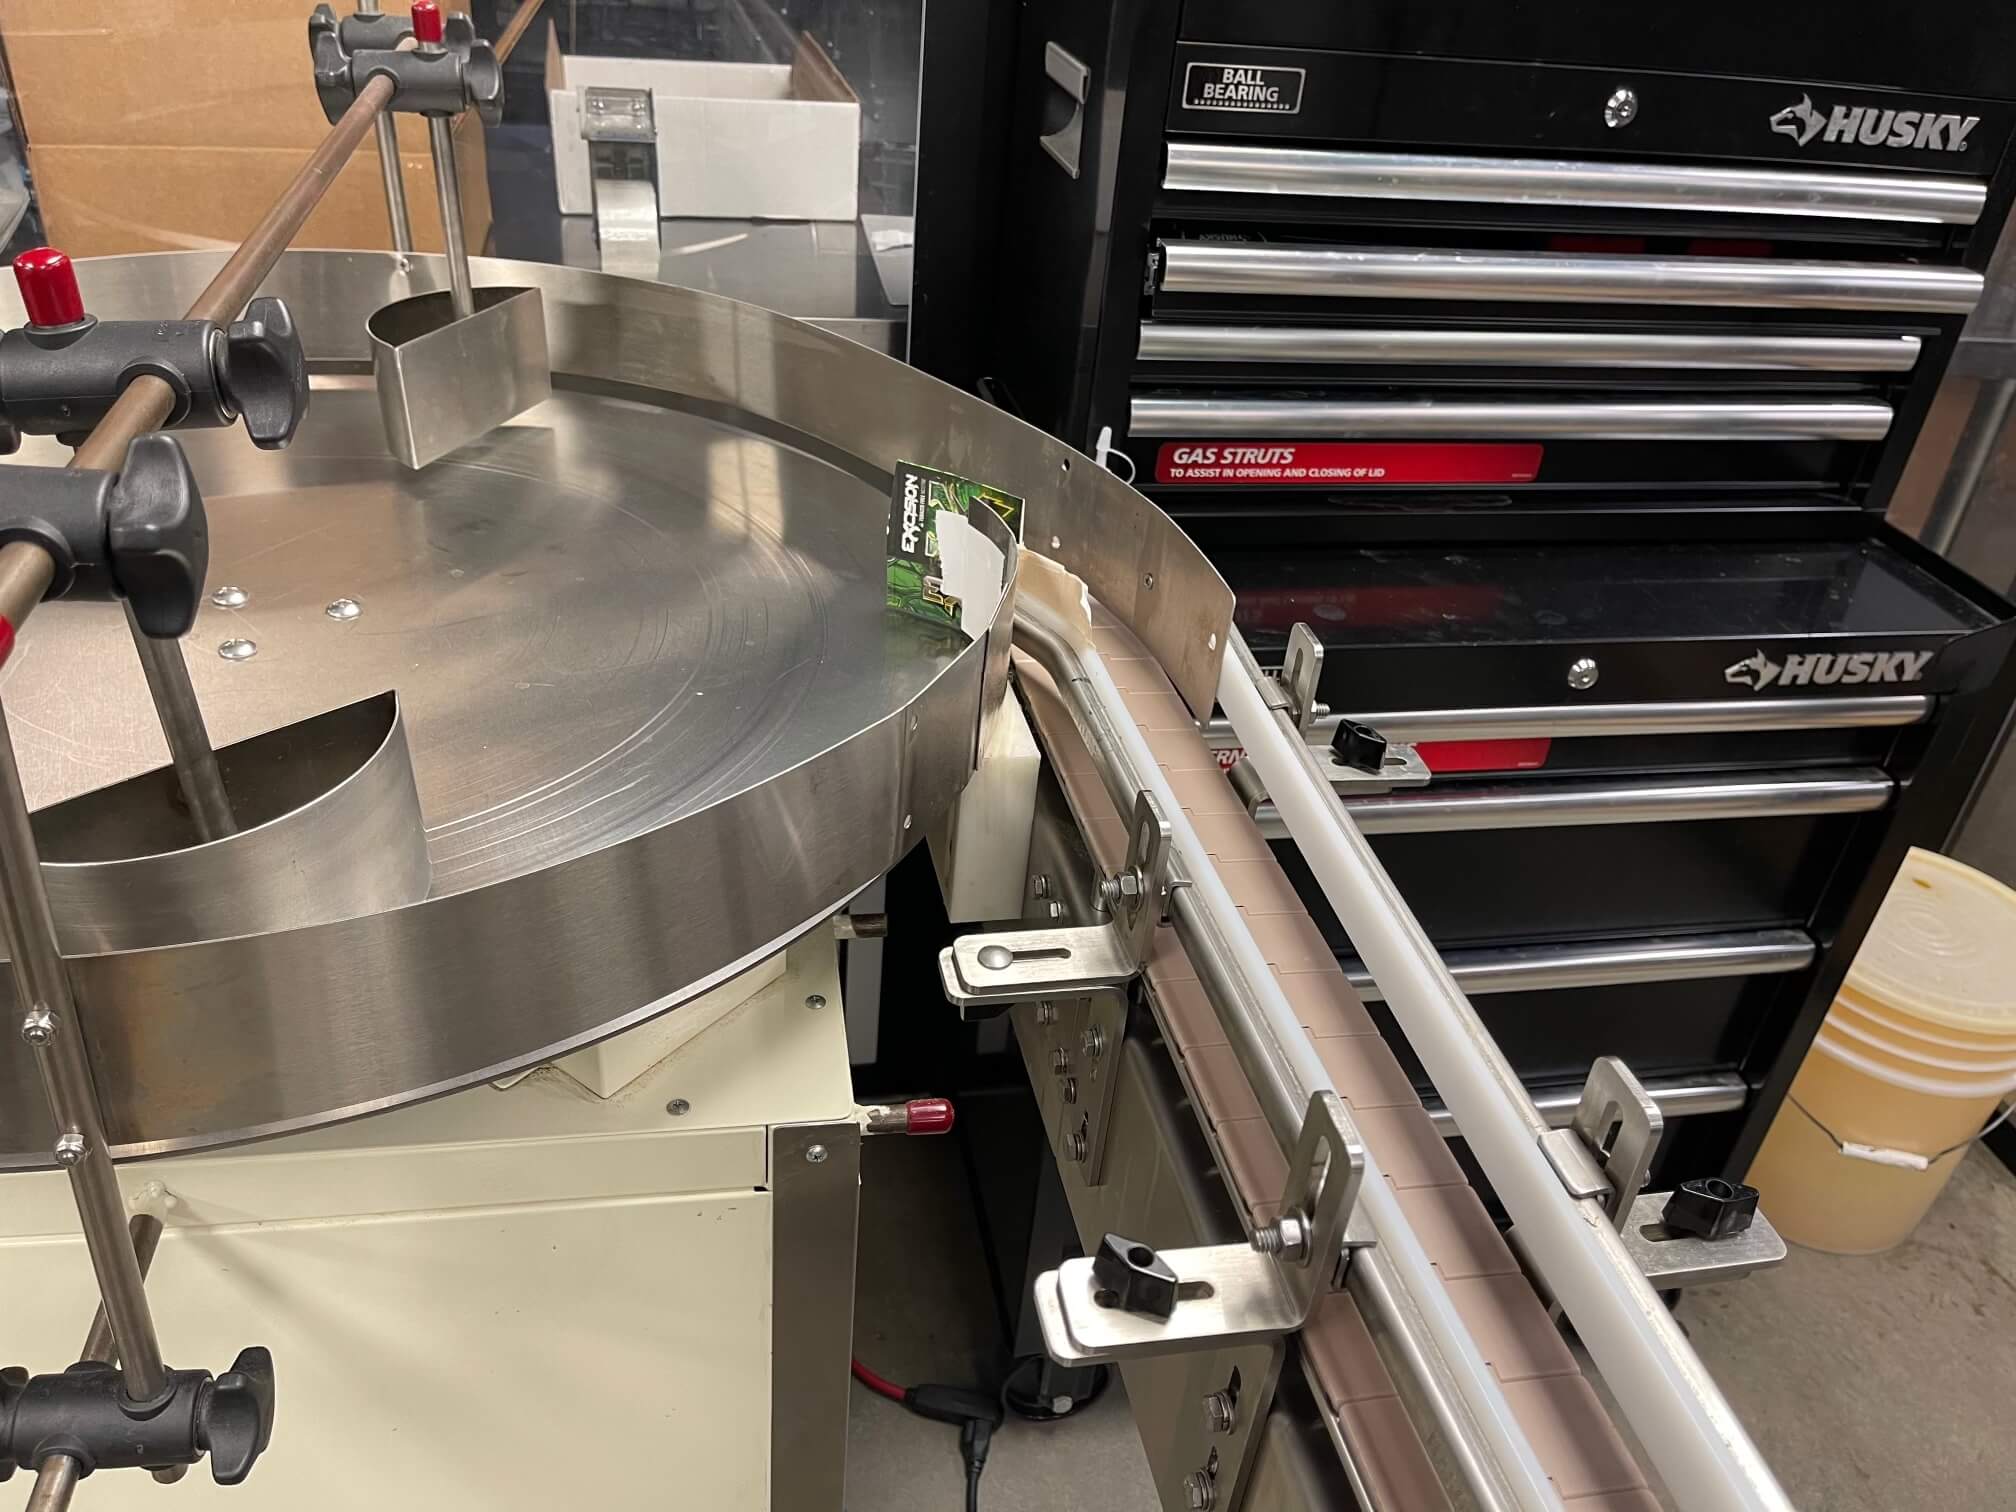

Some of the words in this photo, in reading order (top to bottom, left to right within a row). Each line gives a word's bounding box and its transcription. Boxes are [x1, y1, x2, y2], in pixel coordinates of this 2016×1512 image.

[1222, 68, 1265, 86] BALL
[1202, 83, 1280, 102] BEARING
[1822, 104, 1981, 151] HUSKY
[1173, 447, 1218, 465] GAS
[1220, 447, 1296, 465] STRUTS
[1170, 468, 1184, 478] TO
[1185, 468, 1221, 478] ASSIST
[1222, 468, 1234, 478] IN
[1236, 468, 1282, 478] OPENING
[1283, 468, 1307, 478] AND
[1308, 468, 1352, 478] CLOSING
[1353, 468, 1368, 478] OF
[1368, 468, 1385, 478] LID
[1777, 651, 1934, 686] HUSKY
